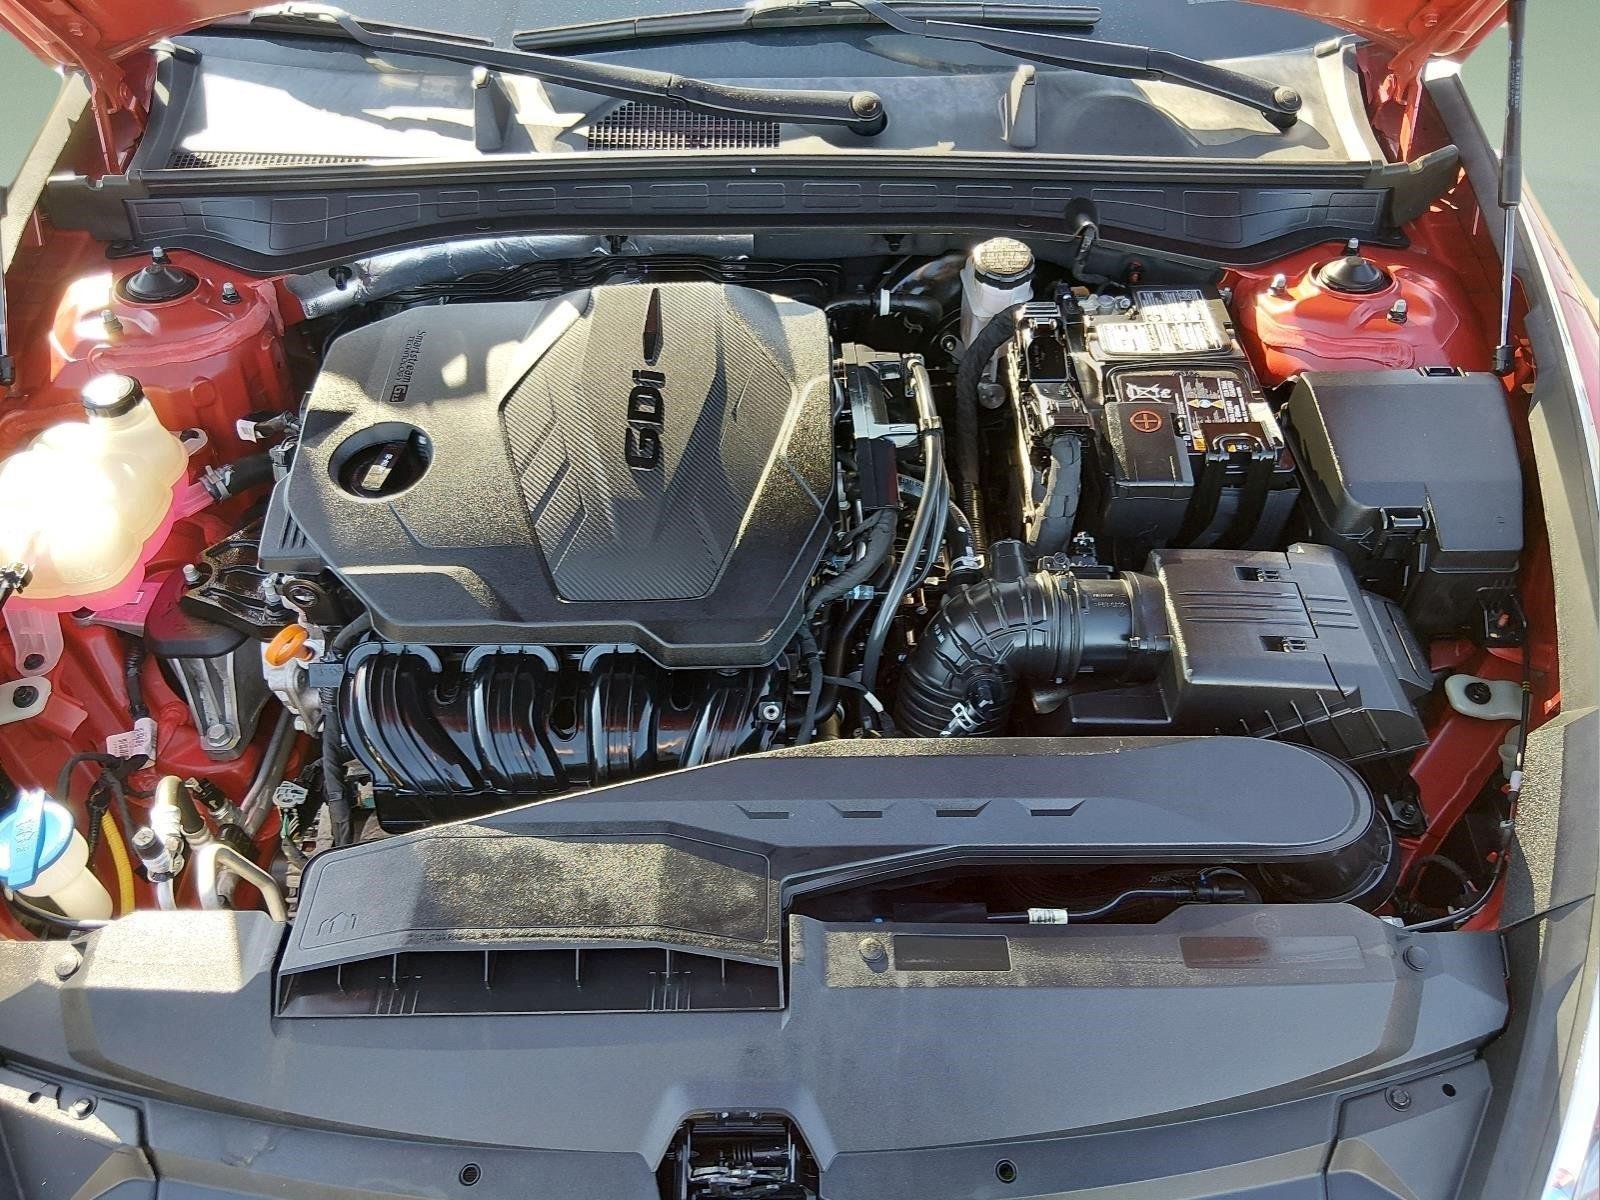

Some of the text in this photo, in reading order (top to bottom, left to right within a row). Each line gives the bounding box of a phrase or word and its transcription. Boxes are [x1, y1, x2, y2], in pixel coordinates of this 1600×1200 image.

[395, 335, 416, 381] TECHNOLOGY
[402, 329, 427, 384] Smartstream
[625, 369, 667, 470] GDi
